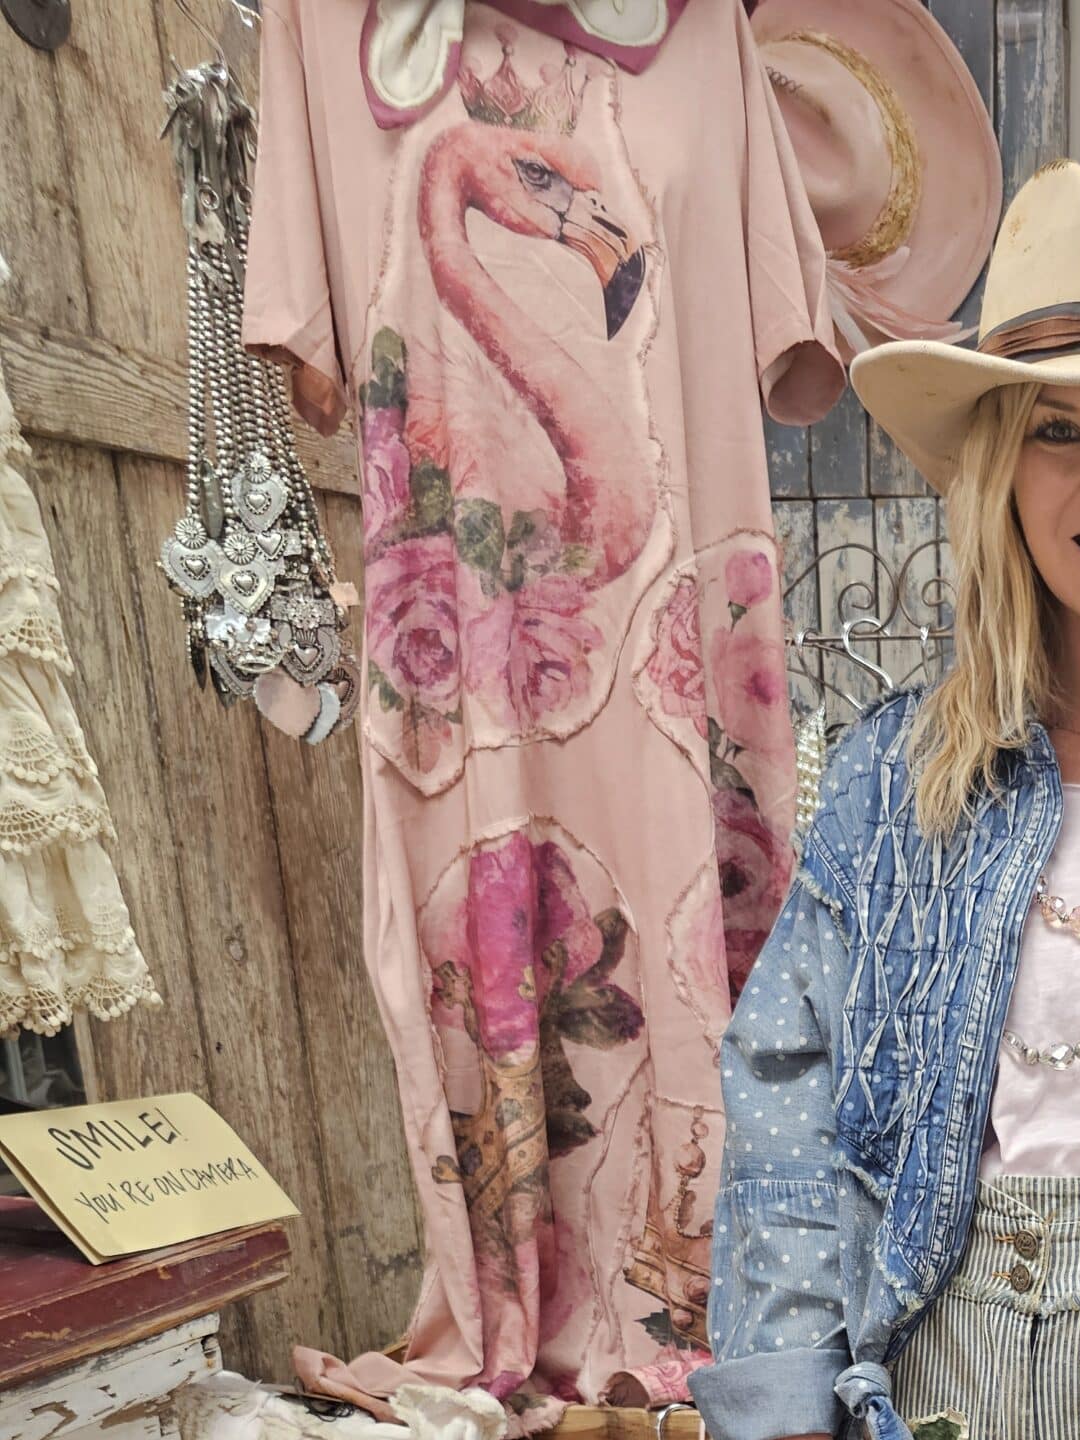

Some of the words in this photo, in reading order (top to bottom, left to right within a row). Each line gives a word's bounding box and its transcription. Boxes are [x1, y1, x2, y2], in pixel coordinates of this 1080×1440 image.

[48, 1107, 189, 1171] SMILE!
[153, 1170, 187, 1196] ON
[187, 1157, 259, 1191] CAMERA
